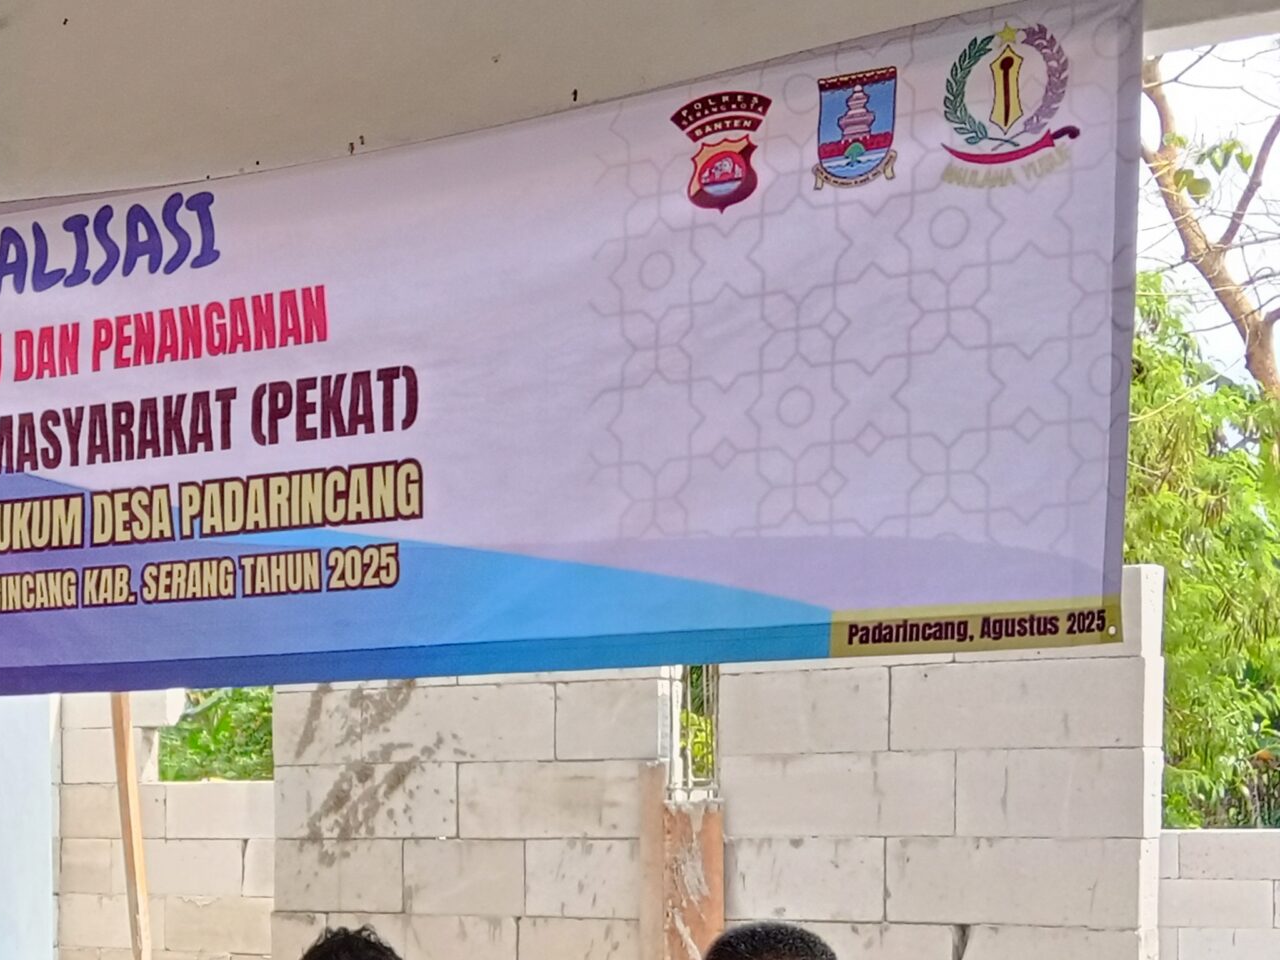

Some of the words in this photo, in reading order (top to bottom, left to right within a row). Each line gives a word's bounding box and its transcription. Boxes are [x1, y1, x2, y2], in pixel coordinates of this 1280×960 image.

[681, 94, 759, 117] POLRES
[694, 120, 752, 136] BANTEN
[13, 321, 80, 383] DAN
[91, 284, 329, 371] PENANGANAN
[251, 364, 419, 446] (PEKAT)
[91, 484, 173, 547] DESA
[180, 458, 423, 539] PADARINCANG
[83, 563, 136, 606] KAB.
[141, 556, 234, 601] SERANG
[239, 549, 320, 597] TAHUN
[325, 544, 399, 591] 2025
[848, 619, 975, 645] Padarincang,
[980, 614, 1059, 640] Agustus
[1066, 609, 1106, 635] 2025
